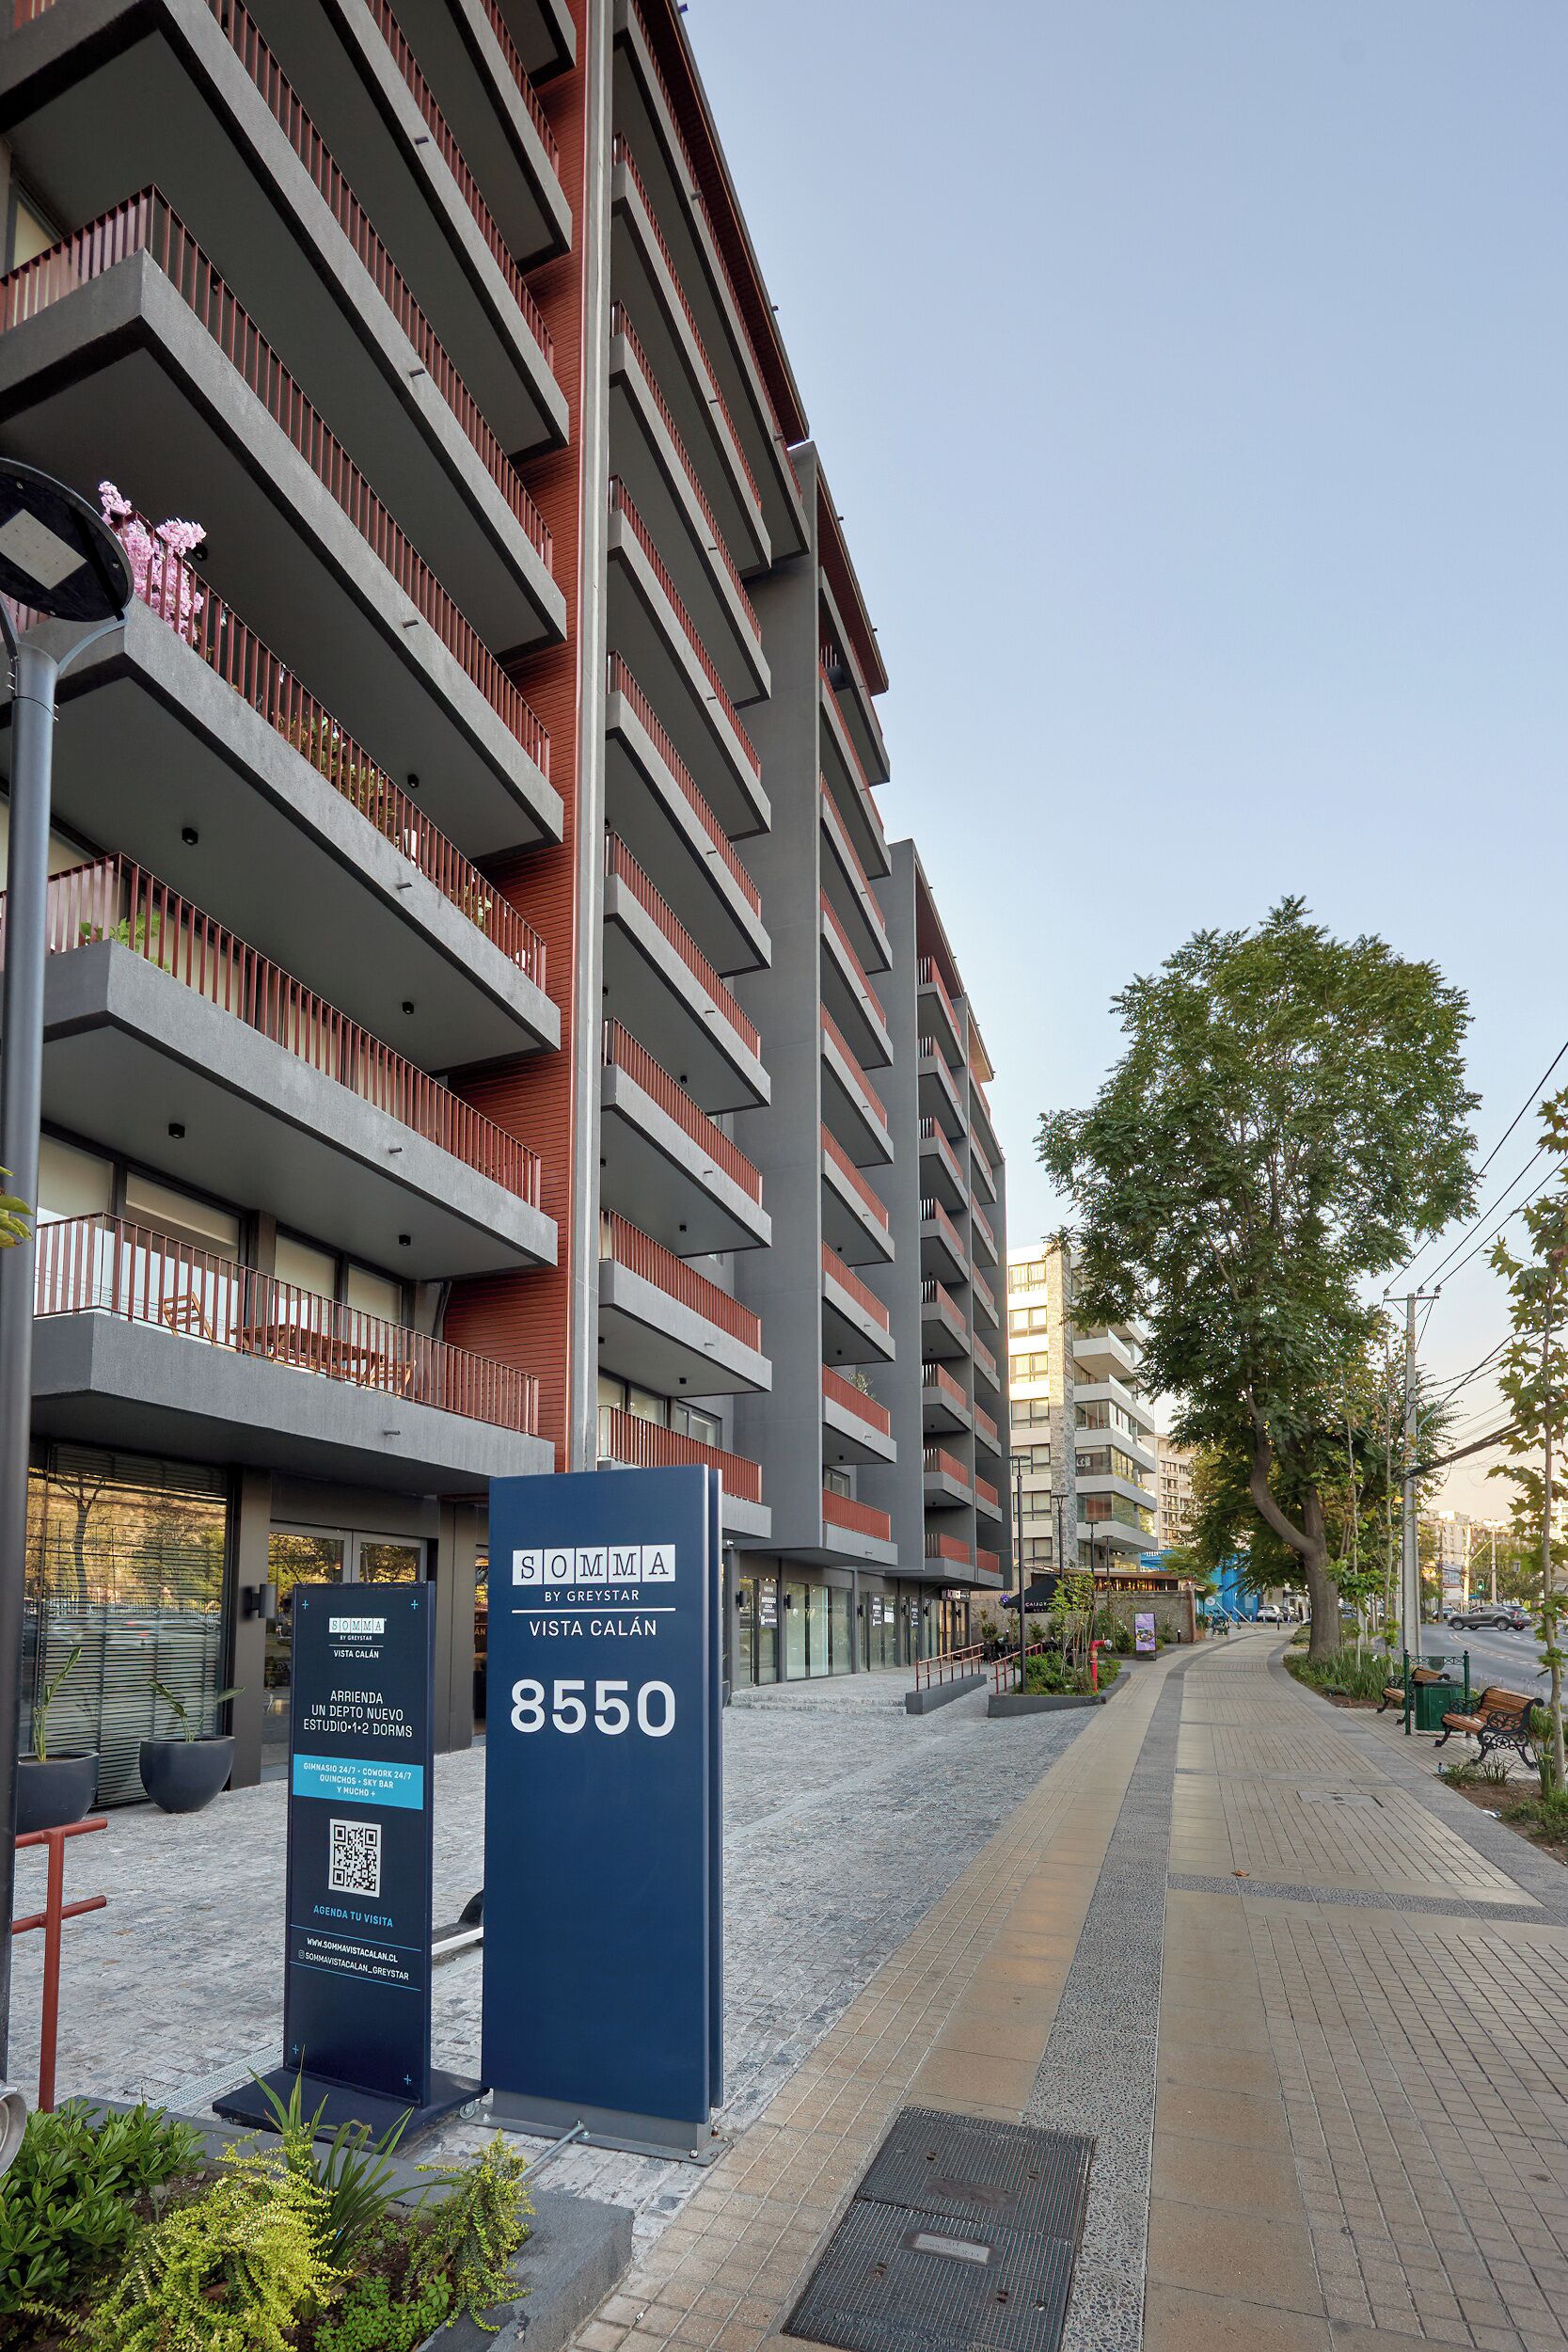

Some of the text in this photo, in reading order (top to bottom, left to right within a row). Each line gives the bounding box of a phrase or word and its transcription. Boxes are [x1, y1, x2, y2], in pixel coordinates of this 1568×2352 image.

[517, 1549, 671, 1581] SOMMA
[545, 1589, 640, 1602] BY GREYSTAR
[330, 1619, 384, 1632] SOMMA
[529, 1615, 657, 1637] VISTA CALÁN
[334, 1648, 379, 1659] VISTA CALÁN
[330, 1690, 384, 1705] ARRIENDA
[311, 1704, 404, 1722] UN DEPTO NUEVO
[511, 1678, 676, 1738] 8550
[372, 1723, 413, 1738] DORMS
[303, 1762, 412, 1780] GIMNASIO 24/7 COWORK 24/7
[320, 1773, 394, 1788] QUINCHOS SKY BAR
[337, 1786, 343, 1794] Y
[343, 1787, 370, 1797] MUCHO
[313, 1904, 394, 1928] AGENDA TU VISITA
[307, 1937, 399, 1963] WWW.SOMMAVISTACALAN.CL
